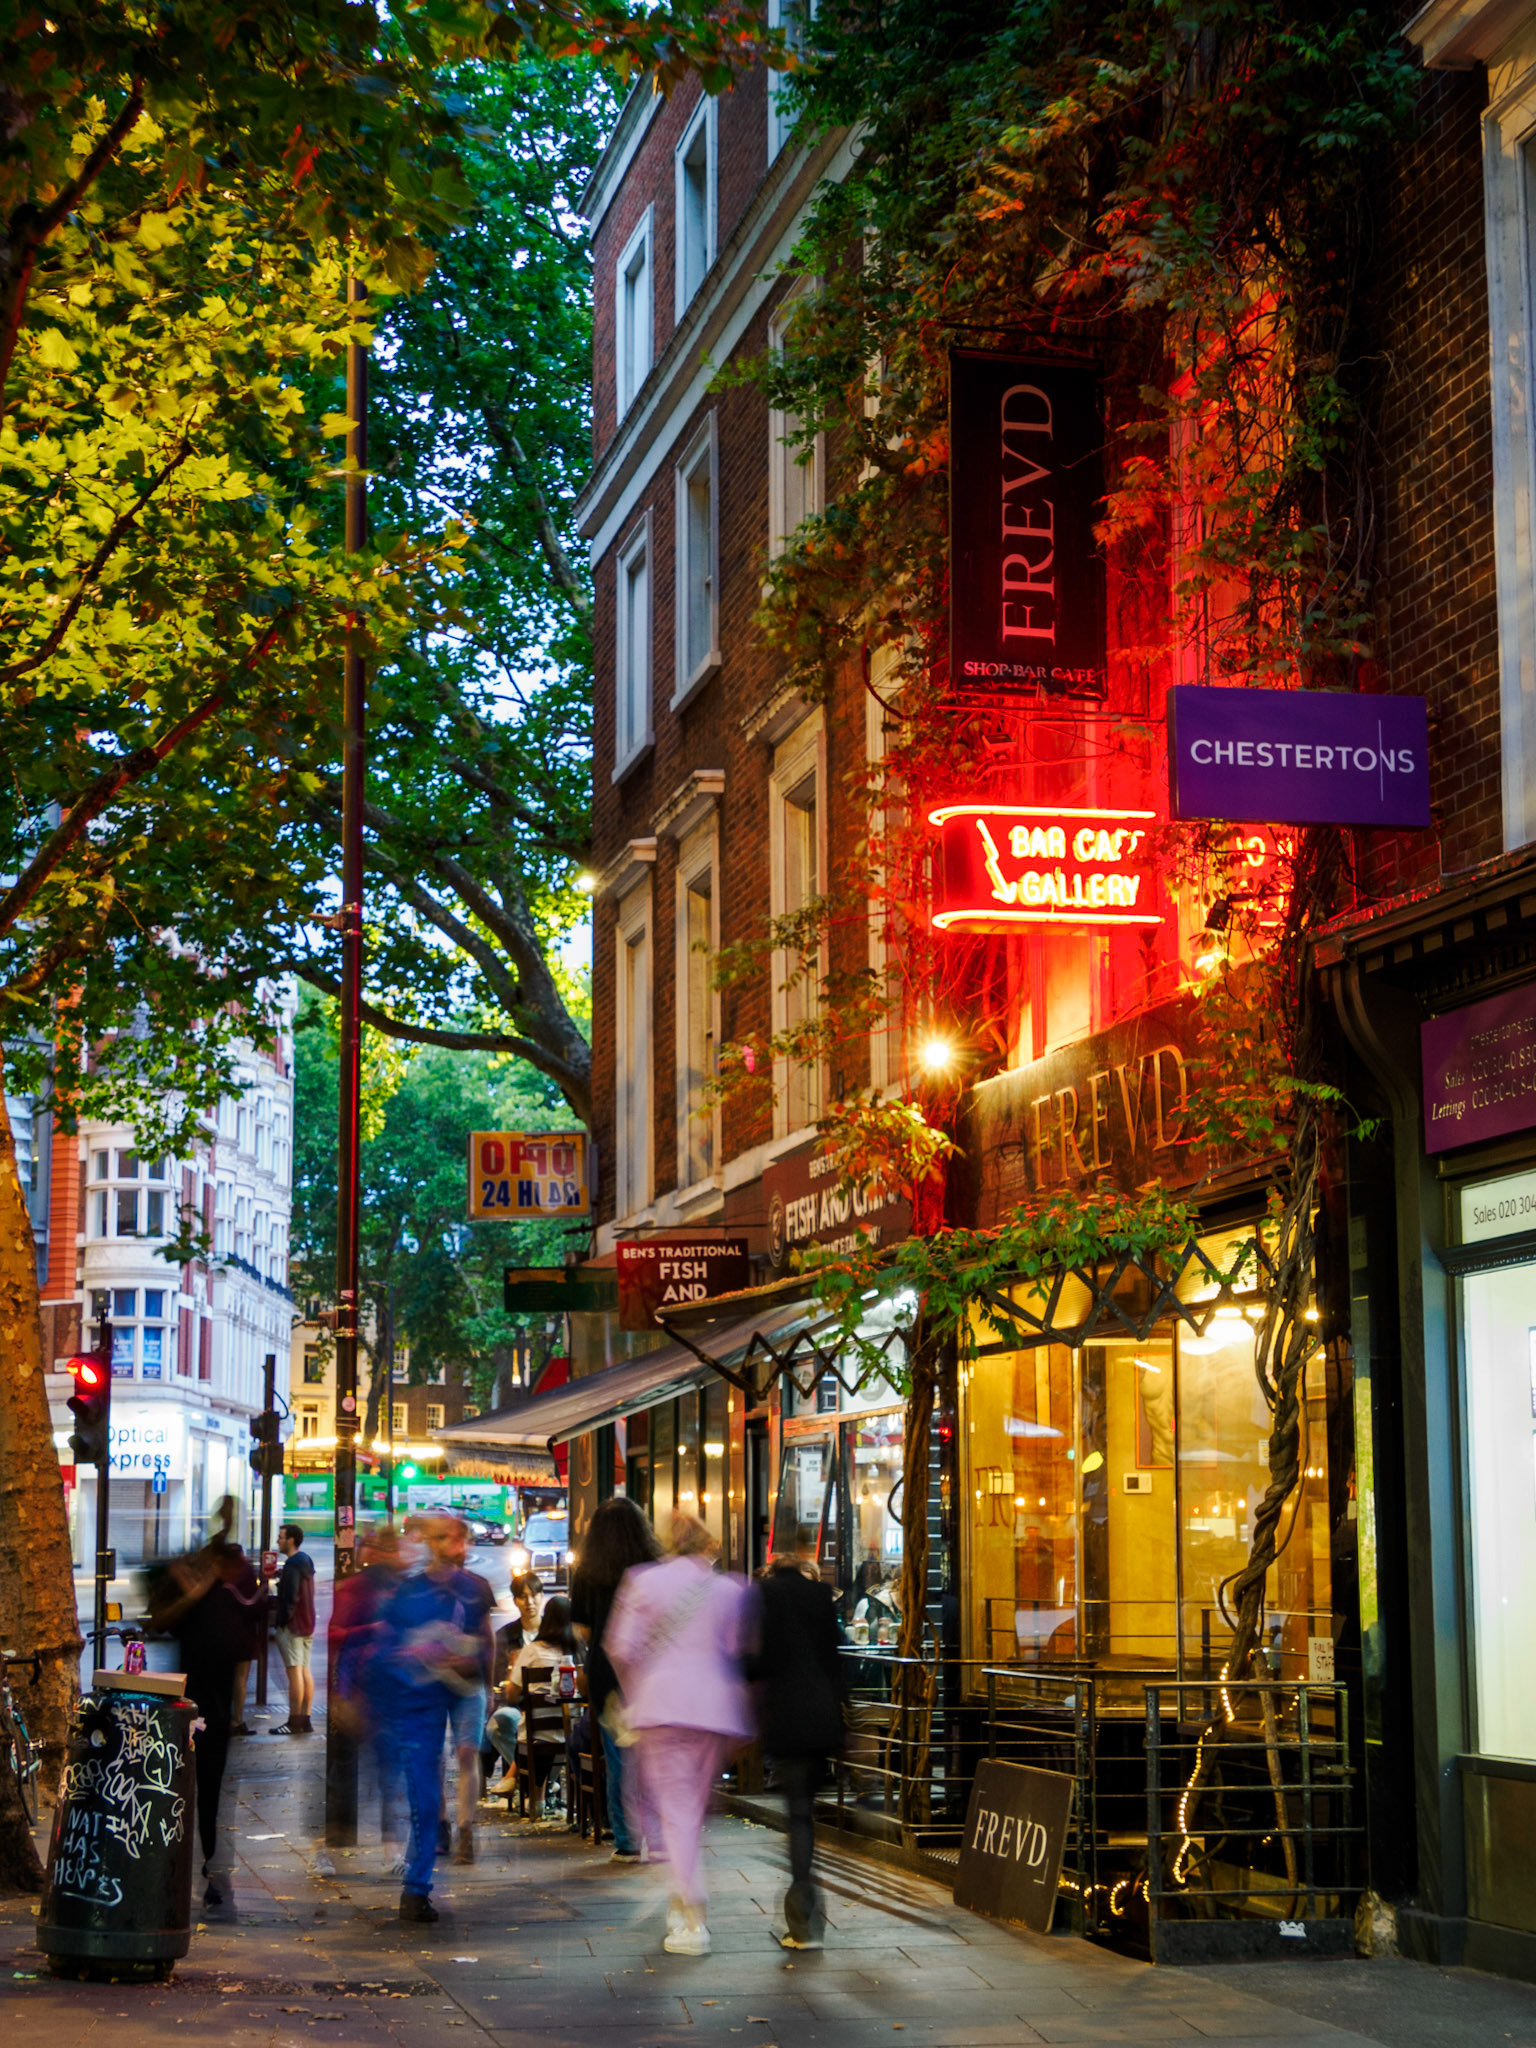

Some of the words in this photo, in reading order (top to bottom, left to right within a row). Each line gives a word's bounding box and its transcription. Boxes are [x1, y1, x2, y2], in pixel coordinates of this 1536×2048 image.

[1001, 384, 1055, 646] FREVD
[1190, 739, 1416, 774] CHESTERTONS
[1009, 825, 1066, 859] BAR
[1019, 870, 1140, 908] GALLERY
[1432, 1098, 1466, 1121] Lettings
[481, 1180, 511, 1208] 24
[785, 1191, 818, 1243] FISH
[1473, 1204, 1497, 1225] Sales
[1498, 1199, 1516, 1219] 020
[622, 1248, 656, 1259] BEN'S
[658, 1245, 742, 1258] TRADITIONAL
[659, 1261, 708, 1280] FISH
[662, 1283, 708, 1302] AND
[107, 1453, 171, 1472] xpress
[972, 1808, 1048, 1868] FREVD
